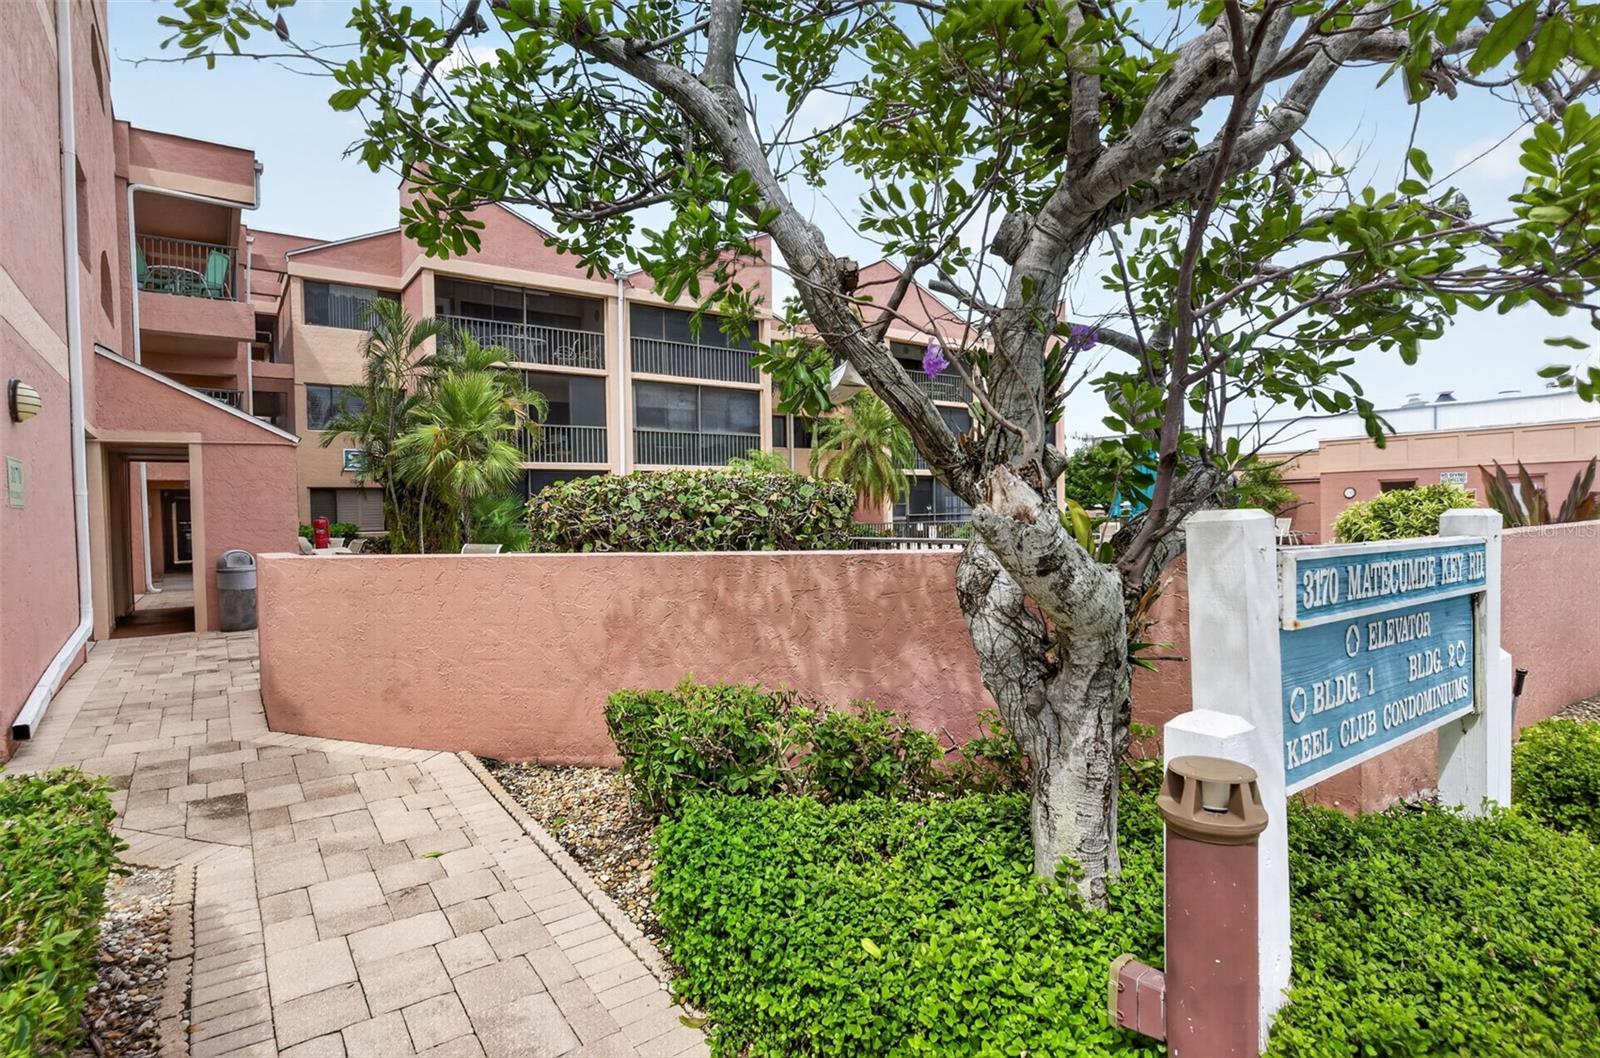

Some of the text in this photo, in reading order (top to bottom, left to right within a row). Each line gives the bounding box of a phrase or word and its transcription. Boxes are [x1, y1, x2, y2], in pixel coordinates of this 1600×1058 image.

[1303, 567, 1339, 609] 3170
[1347, 556, 1436, 600] MATECUMBE
[1441, 552, 1464, 585] KEY
[1368, 611, 1431, 651] ELEVATOR
[1408, 644, 1456, 682] BLDG. 2
[1312, 667, 1376, 715] BLDG. 1
[1285, 675, 1469, 770] KEEL CLUB CONDOMINIUMS
